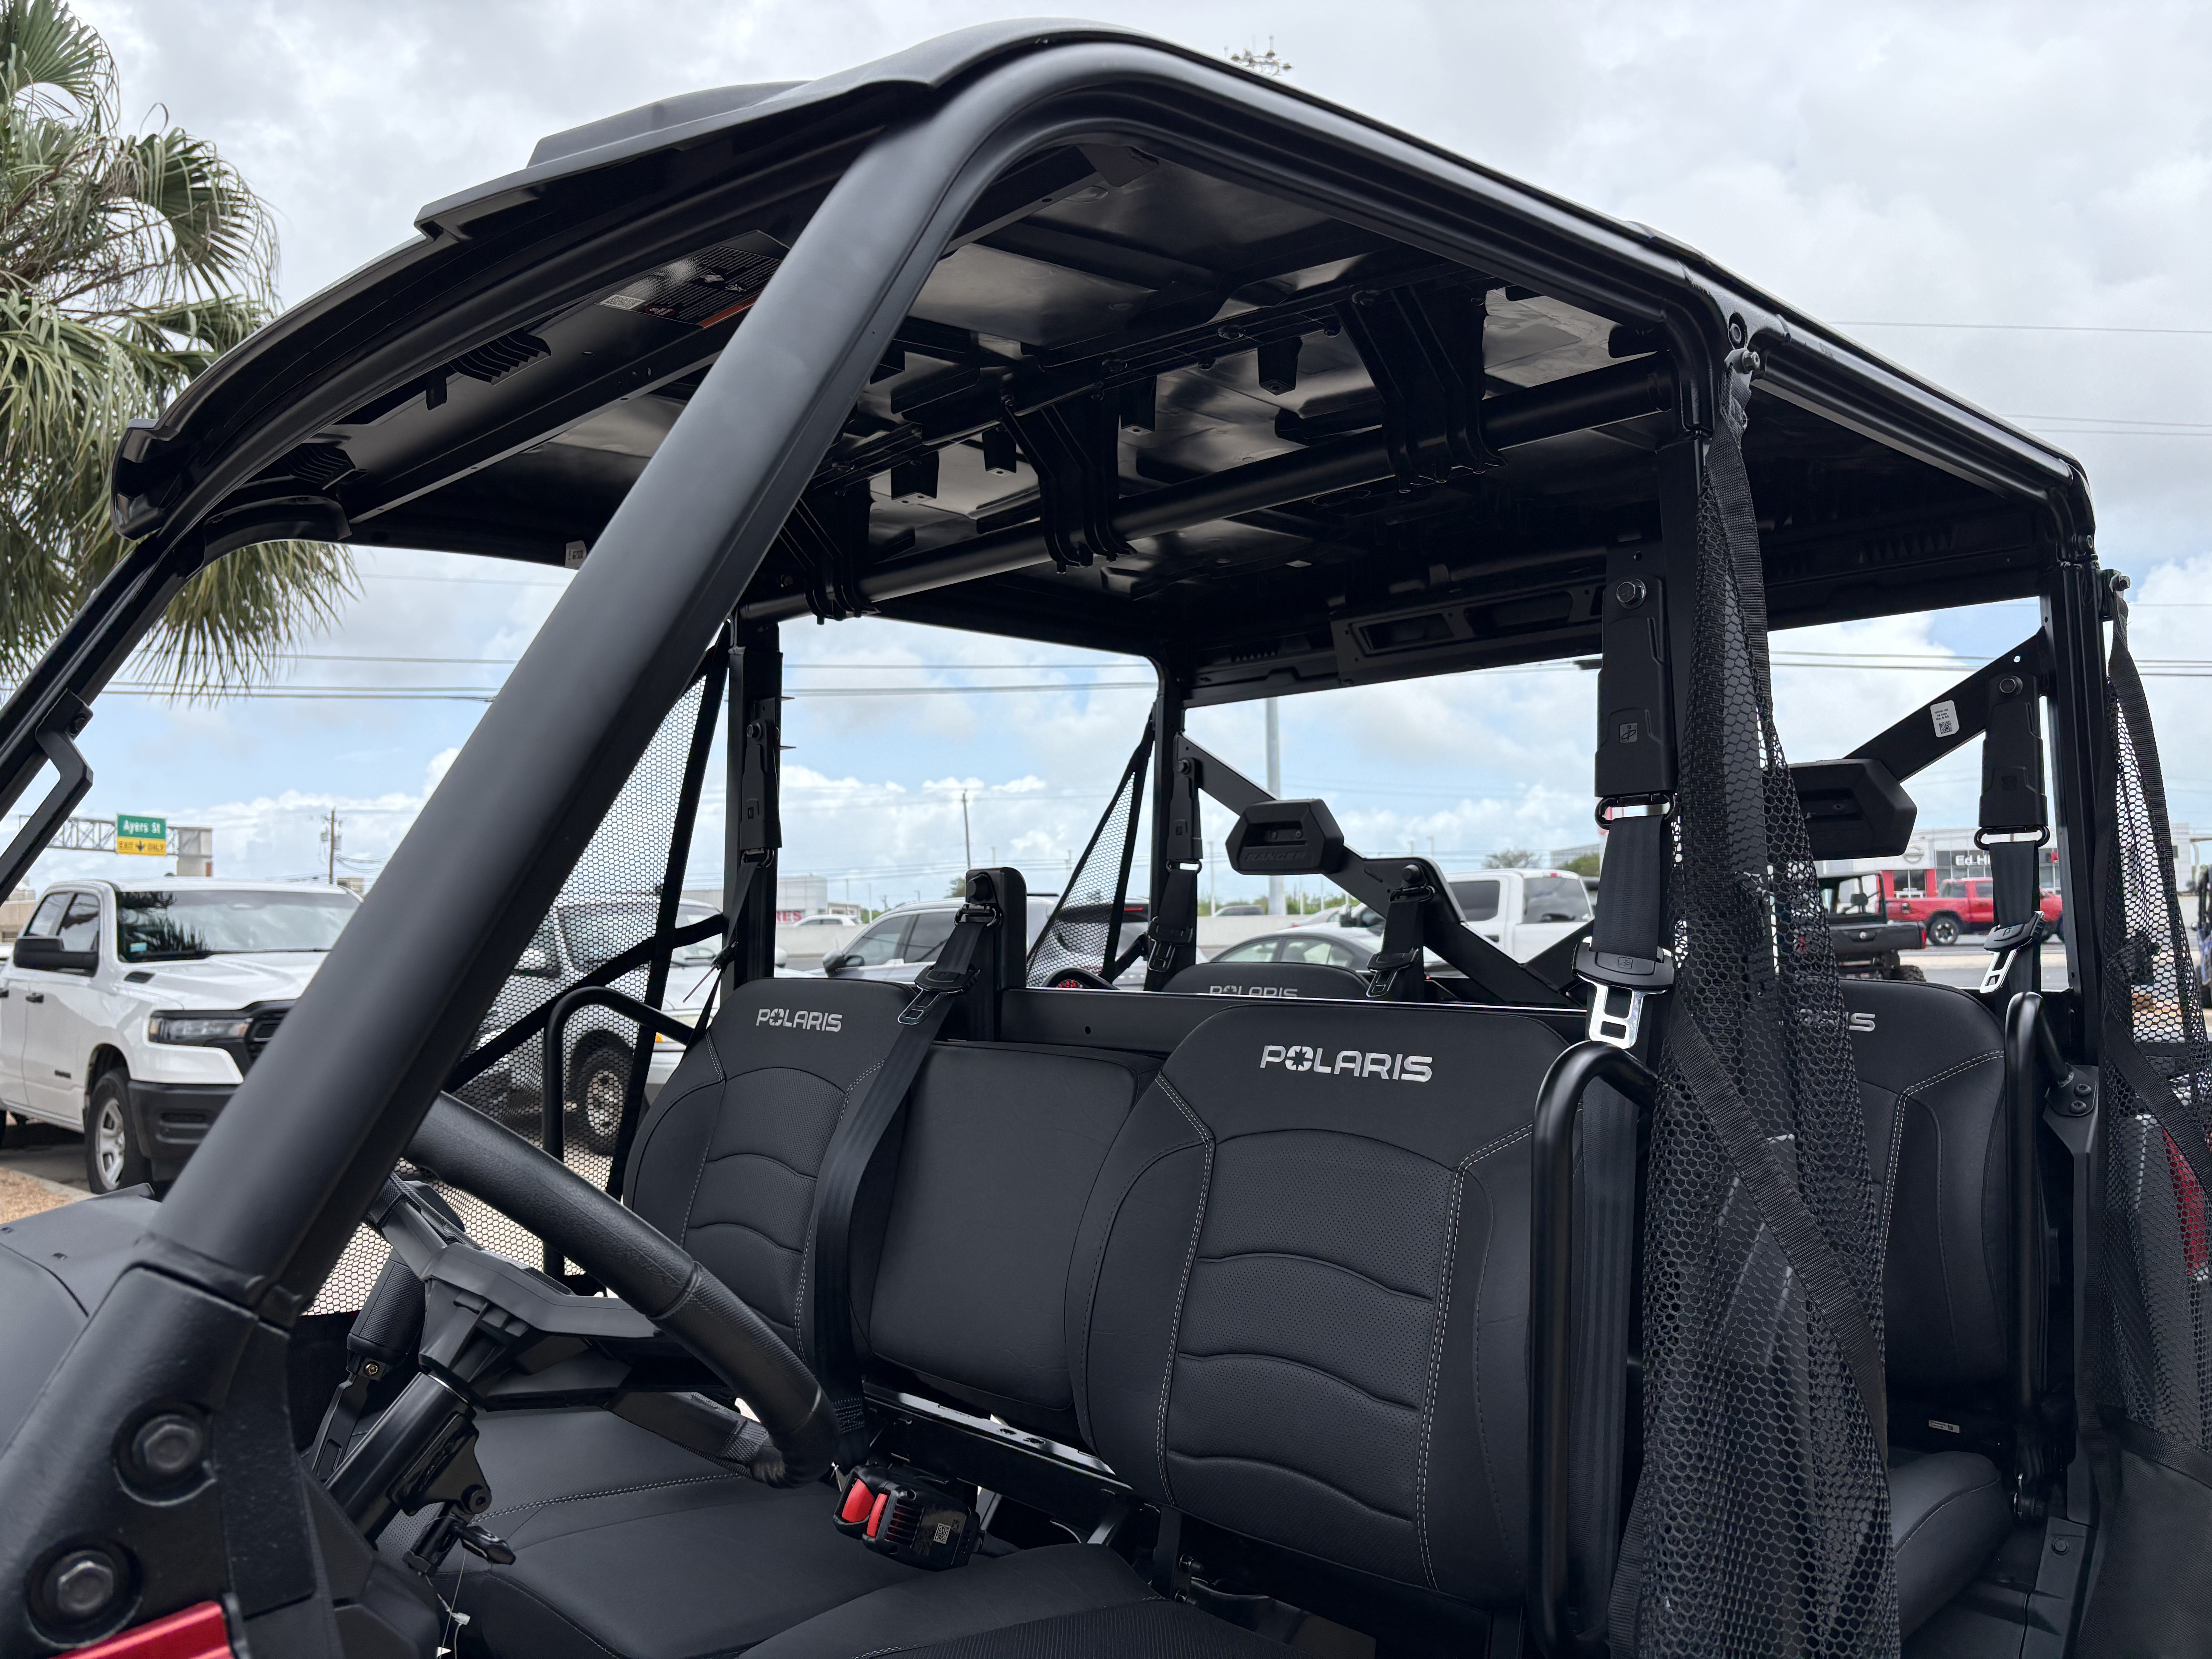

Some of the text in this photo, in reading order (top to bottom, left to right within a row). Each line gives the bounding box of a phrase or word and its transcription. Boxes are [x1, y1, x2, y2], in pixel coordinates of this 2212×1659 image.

[123, 819, 160, 835] Ayers St
[1245, 851, 1306, 861] RANGER
[1956, 855, 1972, 866] Ed
[756, 1008, 842, 1032] POLARIS
[1260, 1045, 1432, 1082] POLARIS
